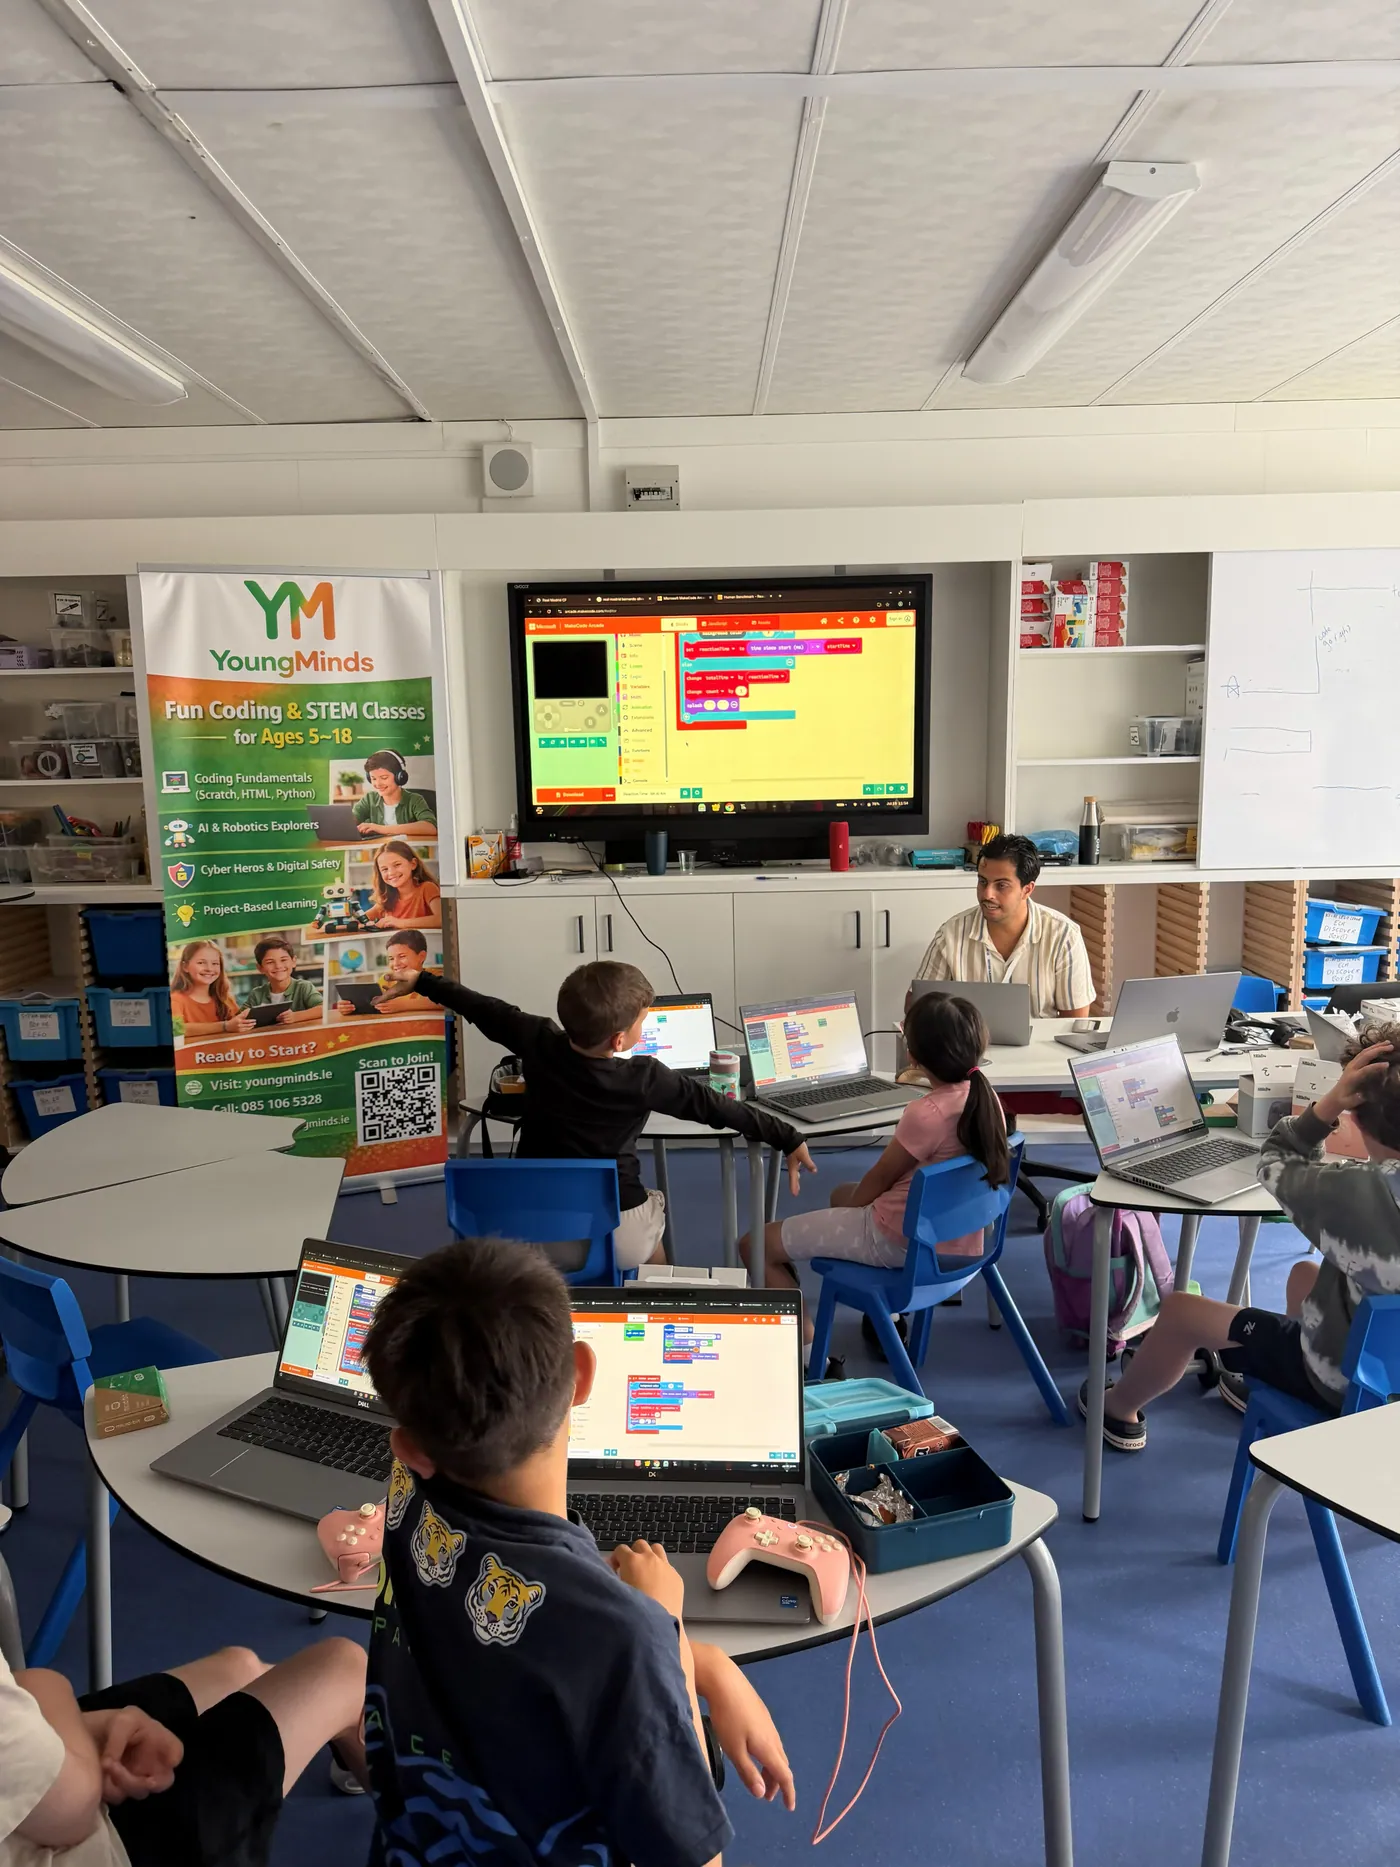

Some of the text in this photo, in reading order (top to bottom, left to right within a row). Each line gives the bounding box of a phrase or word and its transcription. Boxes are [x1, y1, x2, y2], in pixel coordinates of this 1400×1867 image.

[244, 580, 335, 640] YM
[209, 649, 375, 678] YoungMinds
[165, 700, 425, 725] Fun Coding & STEM Classes
[233, 728, 257, 745] for
[261, 728, 304, 748] Ages
[195, 772, 312, 786] Coding Fundamentals
[195, 788, 316, 801] (Scratch, HTML, Python)
[198, 821, 320, 833] AI & Robotics Explorers
[200, 859, 341, 877] Cyber Heros & Digital Safety
[203, 898, 318, 916] Project-Based Learning
[195, 1042, 317, 1065] Ready to Start?
[359, 1052, 435, 1069] Scan to Join!
[210, 1079, 242, 1091] Visit:
[212, 1094, 323, 1113] Call: 085 106 5328
